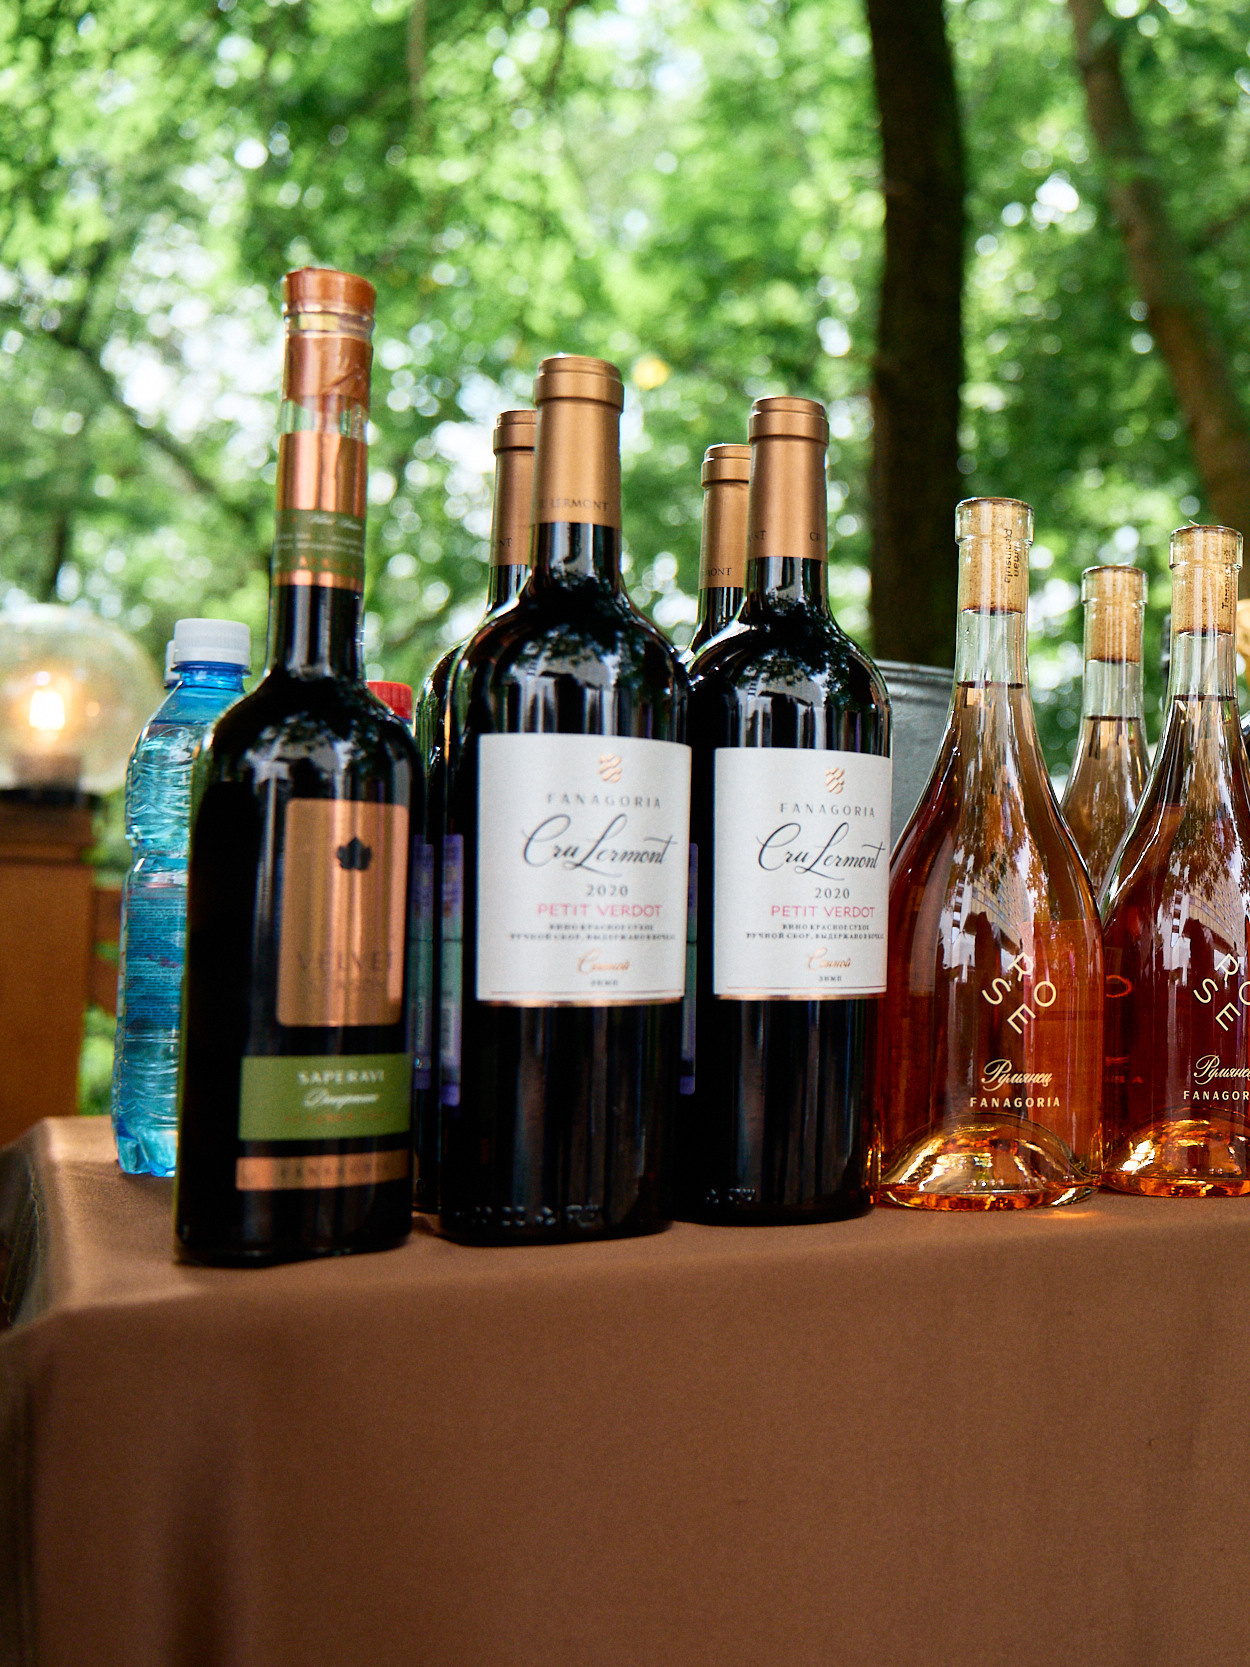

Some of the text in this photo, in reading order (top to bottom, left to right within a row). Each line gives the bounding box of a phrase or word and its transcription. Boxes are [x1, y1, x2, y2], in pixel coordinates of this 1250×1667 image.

[547, 793, 661, 809] FANAGORIA
[780, 802, 875, 817] FANAGORIA
[522, 813, 678, 878] Cru Lermont
[756, 821, 887, 882] Cru Lermont
[586, 884, 629, 898] 2020
[814, 888, 850, 900] 2020
[537, 903, 663, 918] PETIT VERDOT
[770, 905, 876, 918] PETIT VERDOT
[297, 1069, 385, 1086] SAPERAVI
[981, 1058, 1053, 1092] Румянец
[969, 1096, 1060, 1108] FANAGORIA
